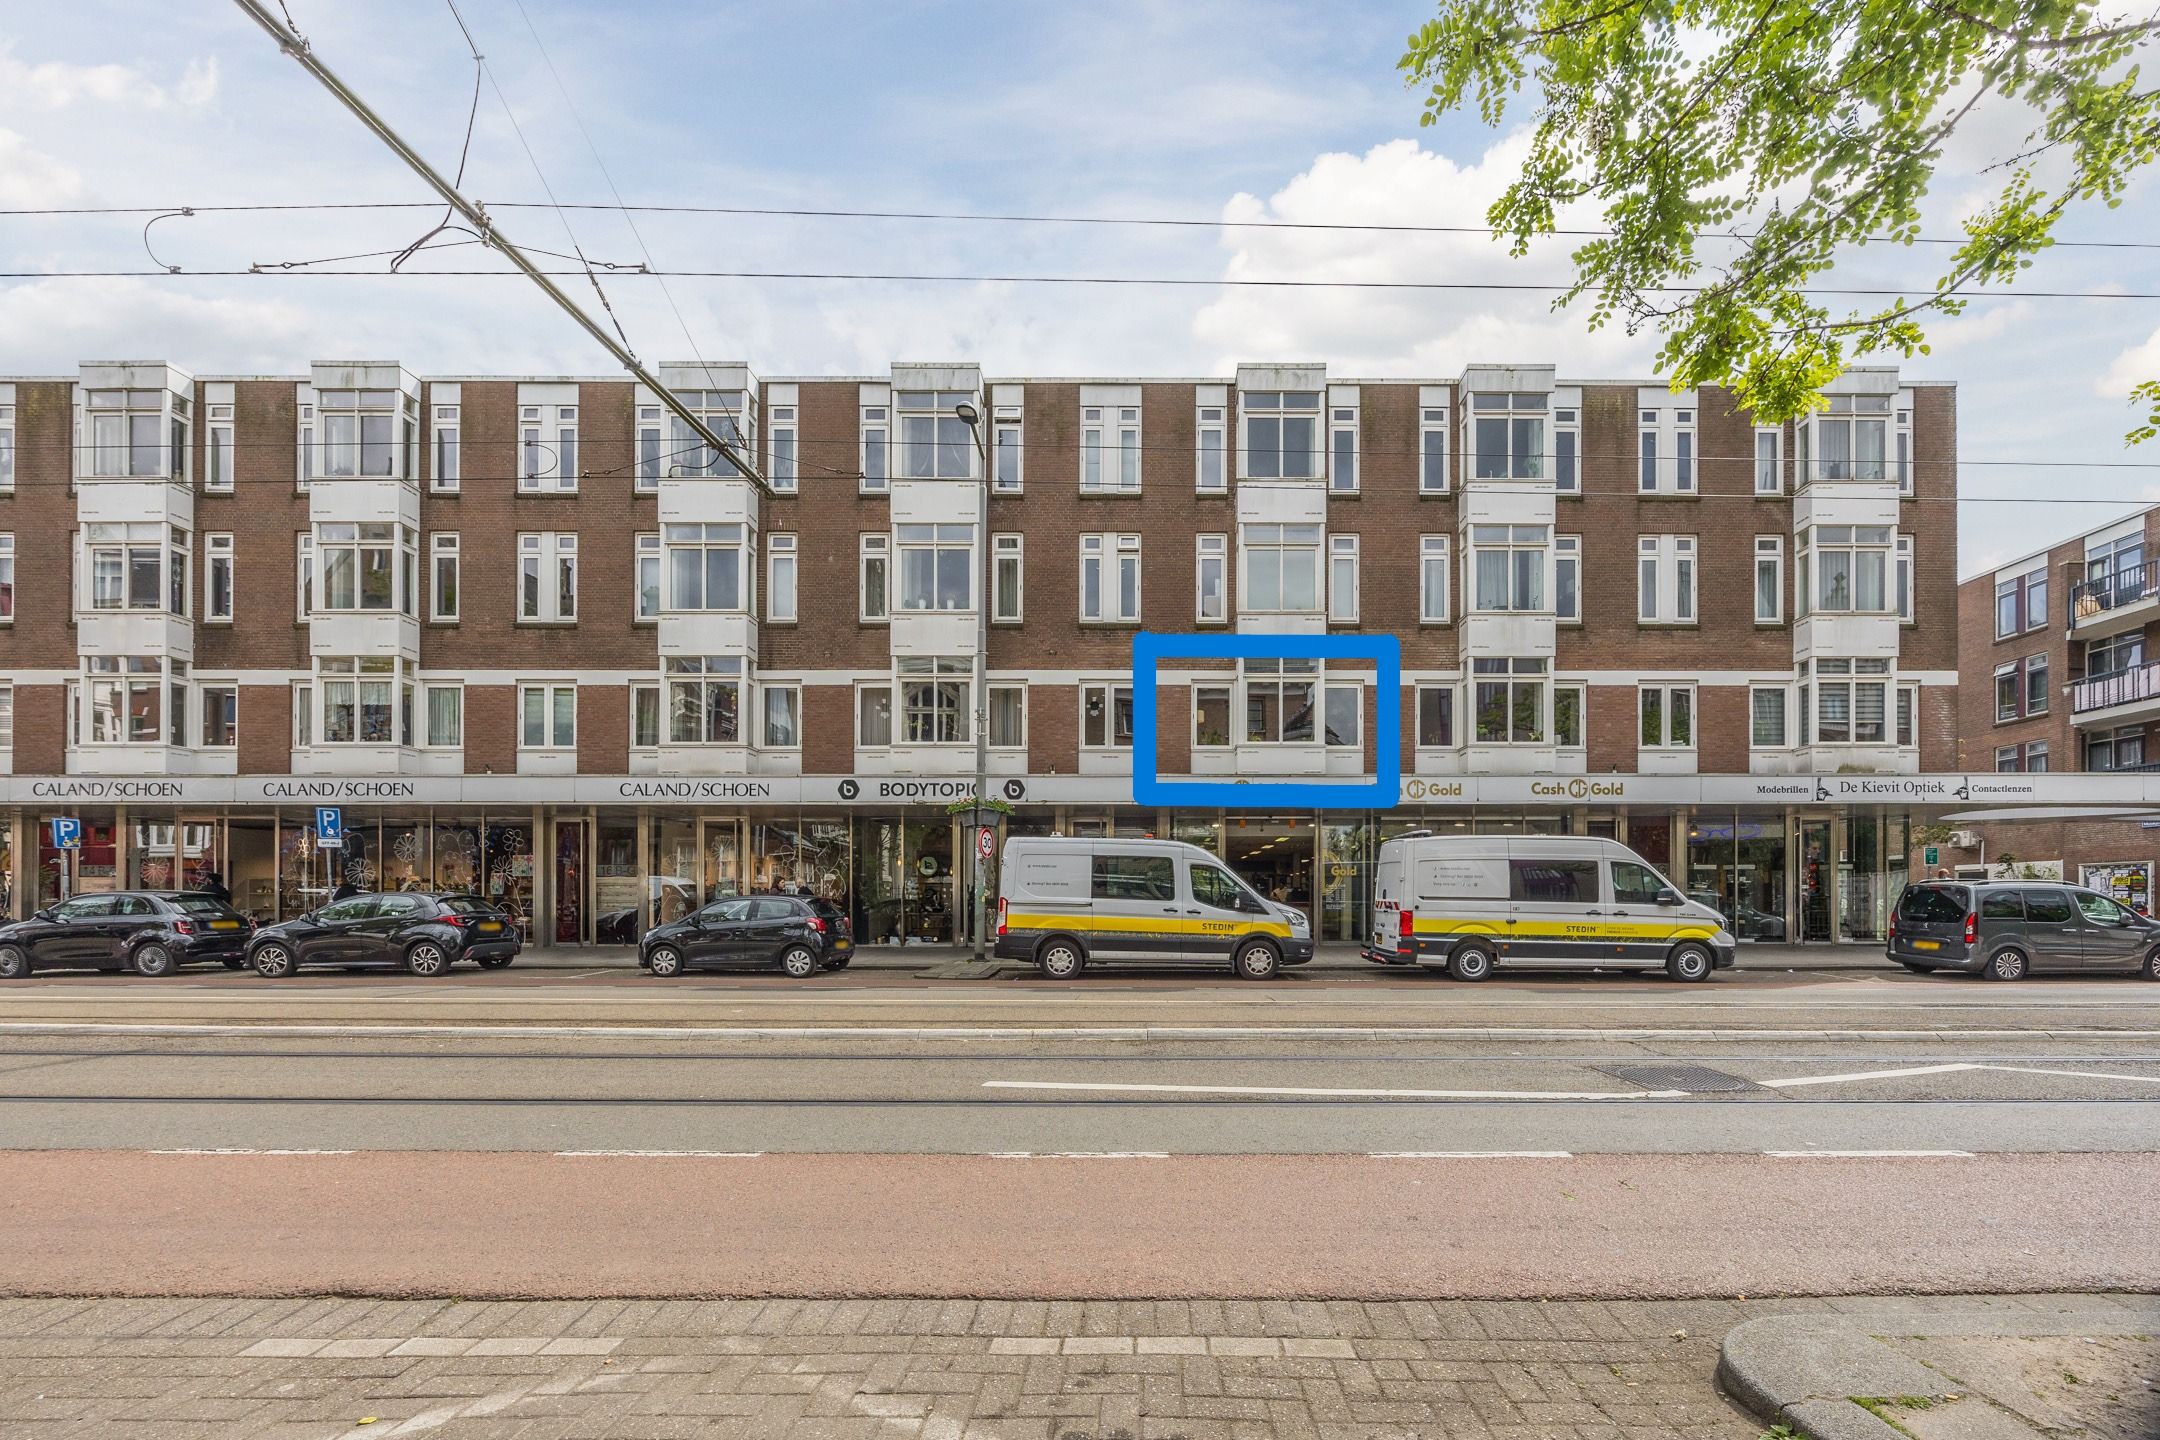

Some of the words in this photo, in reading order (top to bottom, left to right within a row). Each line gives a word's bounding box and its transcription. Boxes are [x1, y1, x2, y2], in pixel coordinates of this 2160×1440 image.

[33, 782, 183, 797] CALAND/SCHOEN
[263, 782, 414, 797] CALAND/SCHOEN
[619, 782, 770, 797] CALAND/SCHOEN
[1429, 783, 1462, 796] Gold
[1531, 782, 1565, 795] Cash
[1591, 782, 1623, 795] Gold
[1757, 785, 1809, 794] Modebrillen
[1840, 781, 1858, 793] De
[1862, 781, 1900, 793] Kievit
[1903, 781, 1945, 796] Optiek
[1972, 784, 2032, 793] Contactlenzen
[323, 810, 335, 827] P
[60, 821, 74, 837] P
[983, 836, 991, 849] 30
[1331, 865, 1357, 876] Gold
[1202, 922, 1234, 931] STEDIN
[1566, 925, 1596, 933] STEDIN
